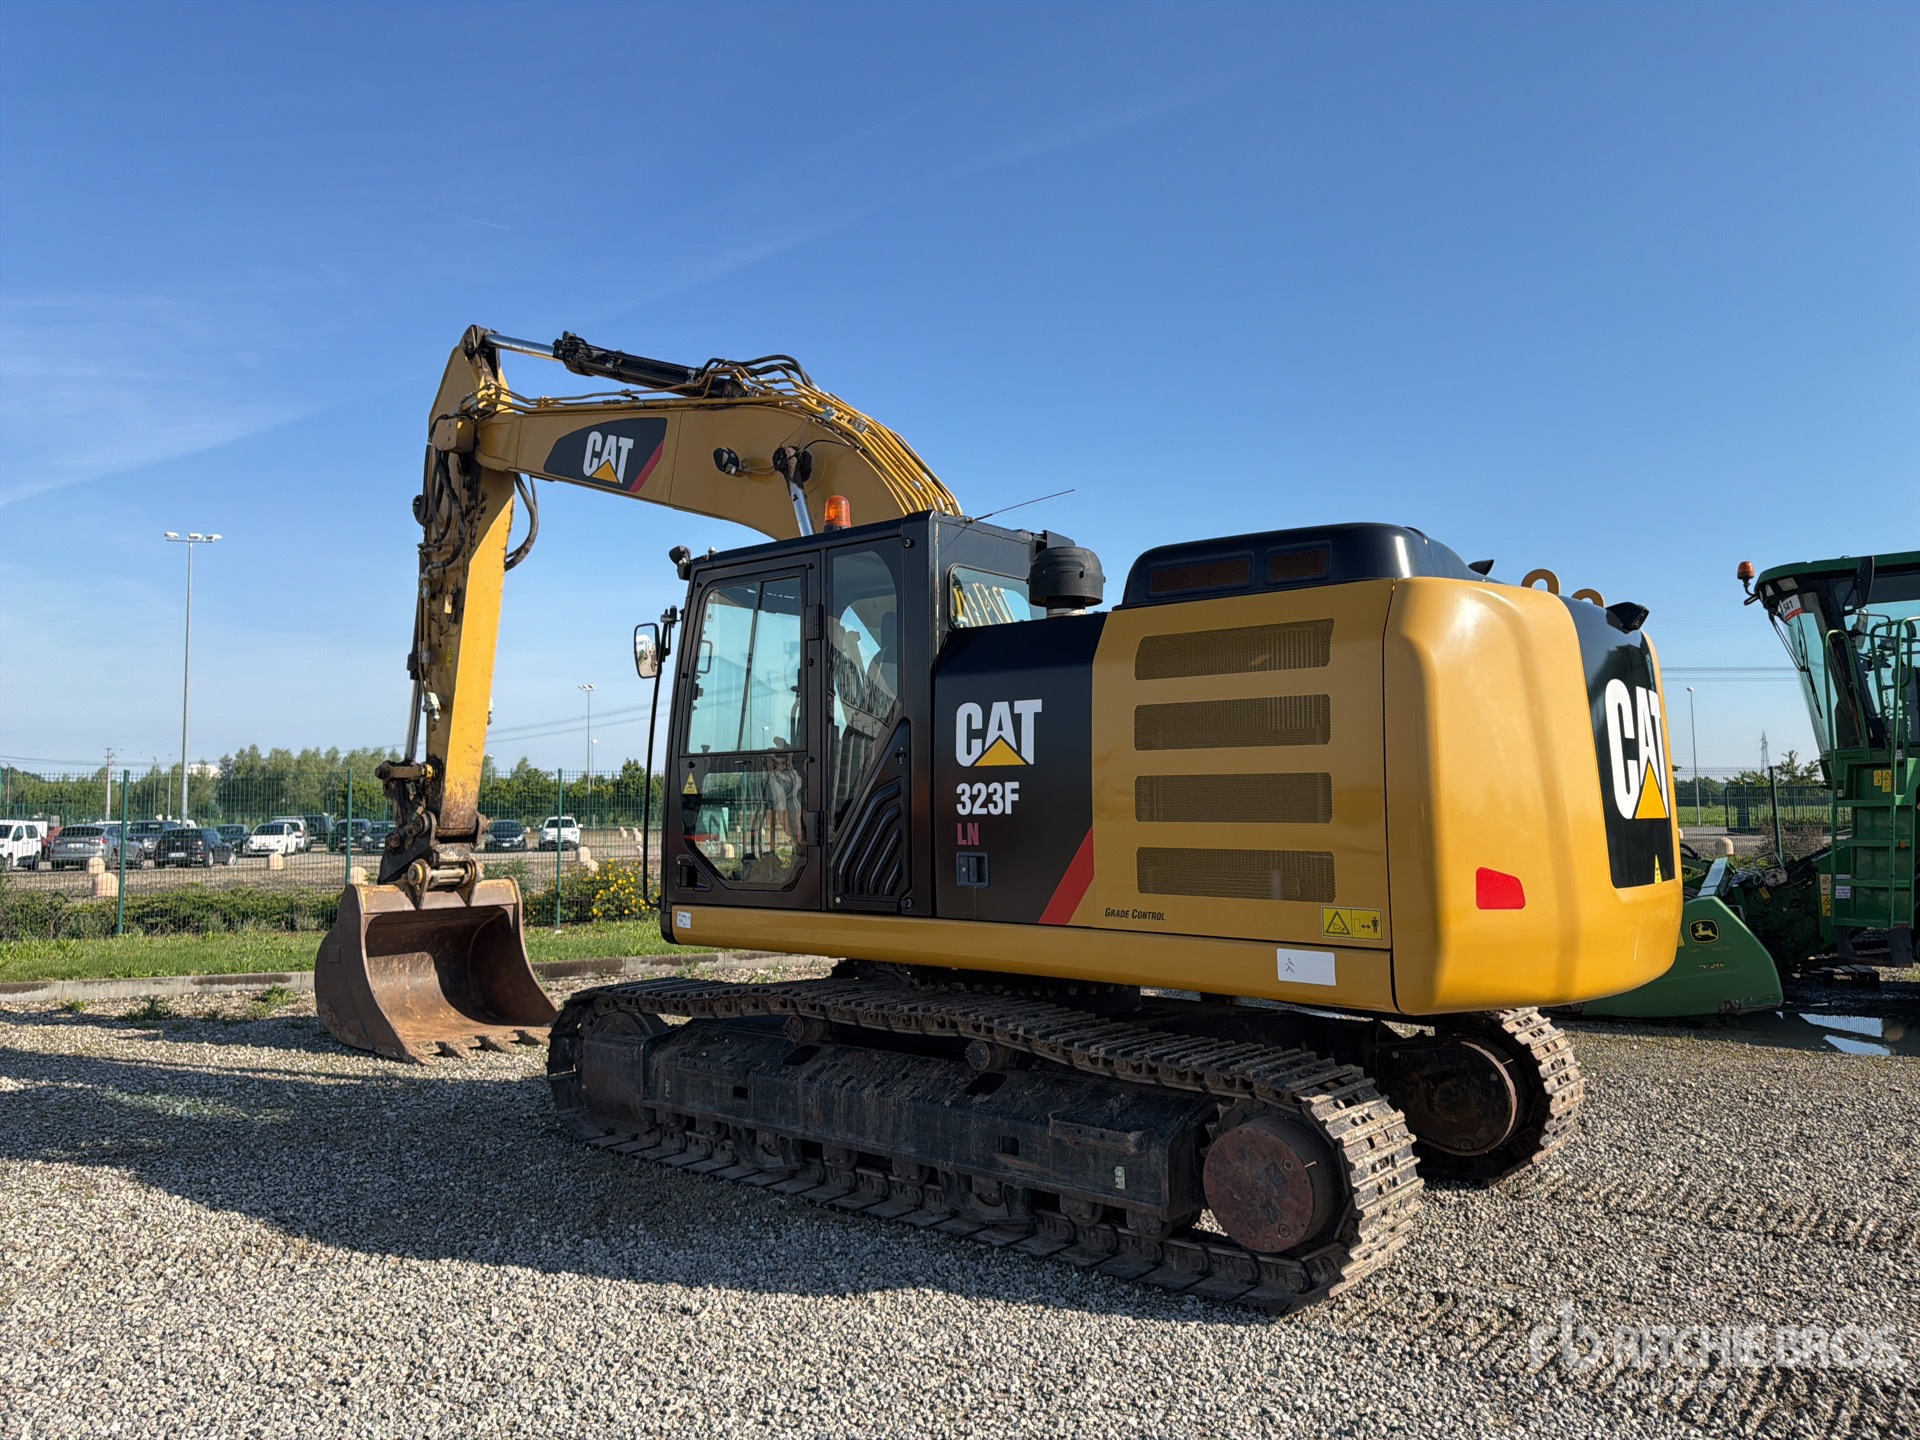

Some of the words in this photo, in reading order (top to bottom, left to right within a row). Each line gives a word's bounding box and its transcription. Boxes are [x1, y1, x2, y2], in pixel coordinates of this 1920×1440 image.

[583, 430, 634, 484] CAT
[956, 699, 1042, 767] CAT
[1605, 678, 1669, 820] CAT
[956, 781, 1020, 815] 323F
[956, 822, 979, 846] LN
[1104, 907, 1130, 919] GRADE
[1131, 908, 1165, 921] CONTROL
